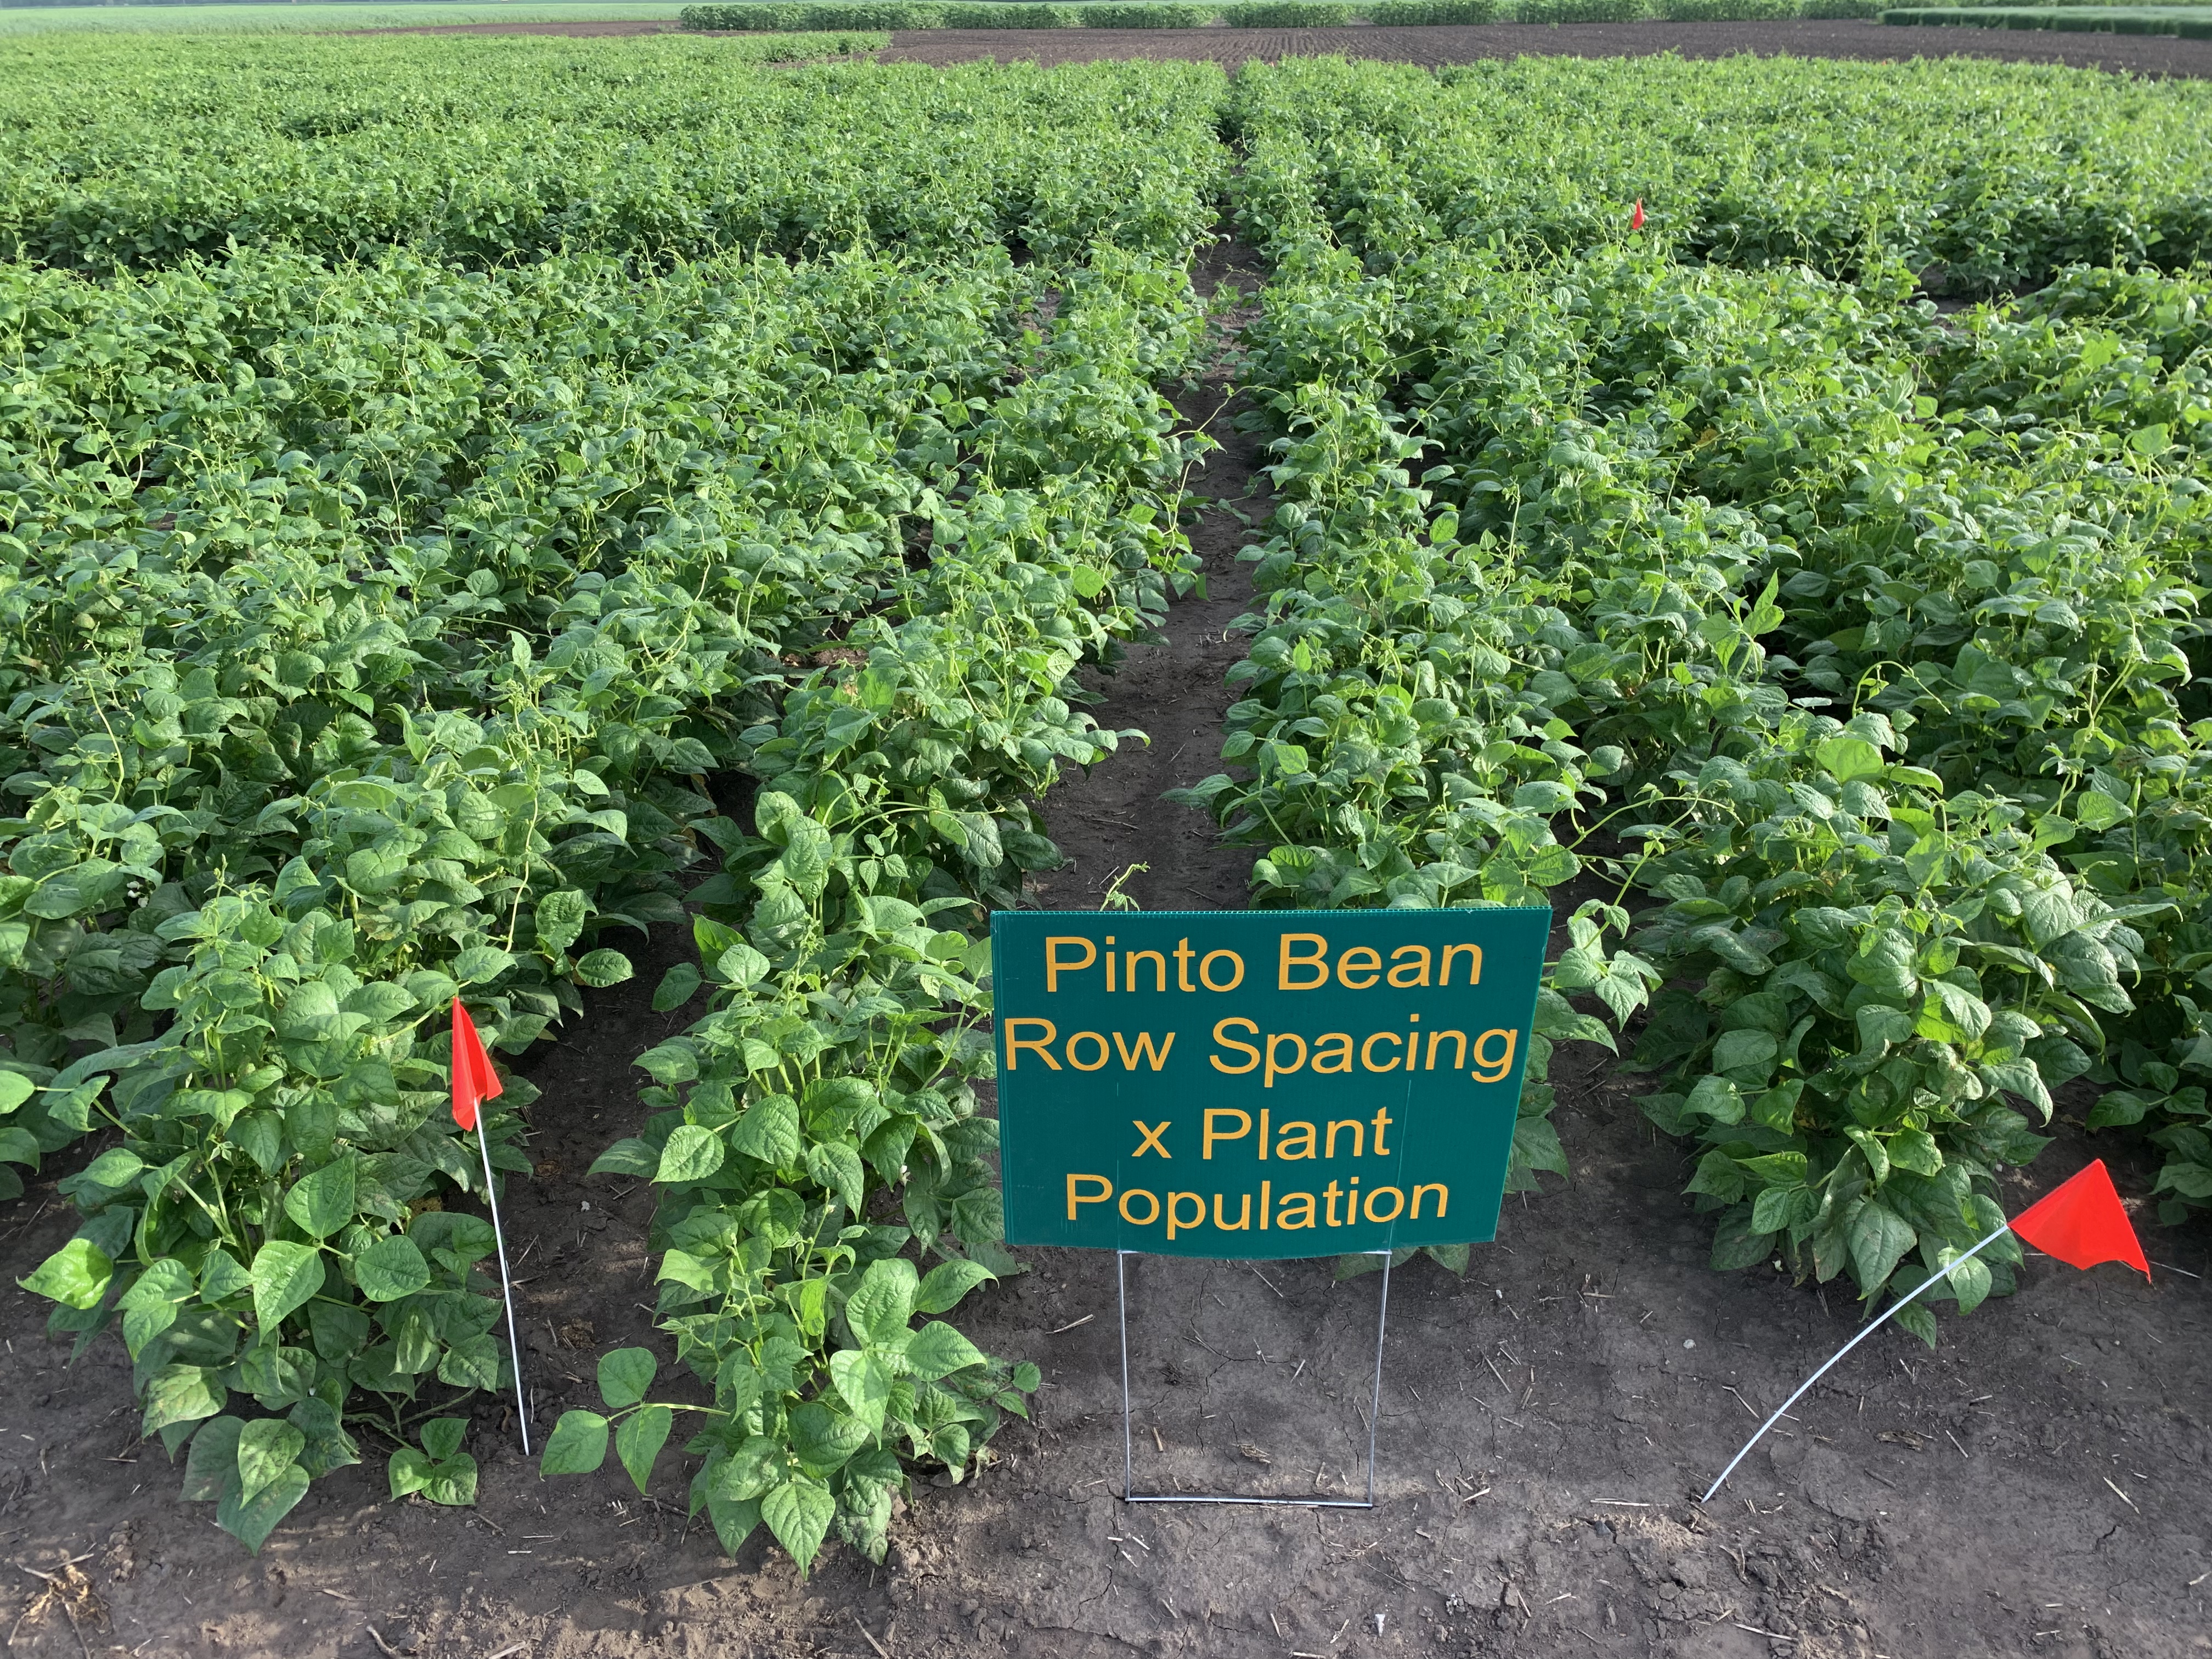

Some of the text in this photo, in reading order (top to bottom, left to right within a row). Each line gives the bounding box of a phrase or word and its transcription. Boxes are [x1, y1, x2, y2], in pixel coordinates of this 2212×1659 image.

[1046, 933, 1482, 992] Pinto Bean
[1005, 1013, 1517, 1088] Row Spacing
[1132, 1107, 1392, 1160] x Plant
[1066, 1173, 1448, 1240] Population
